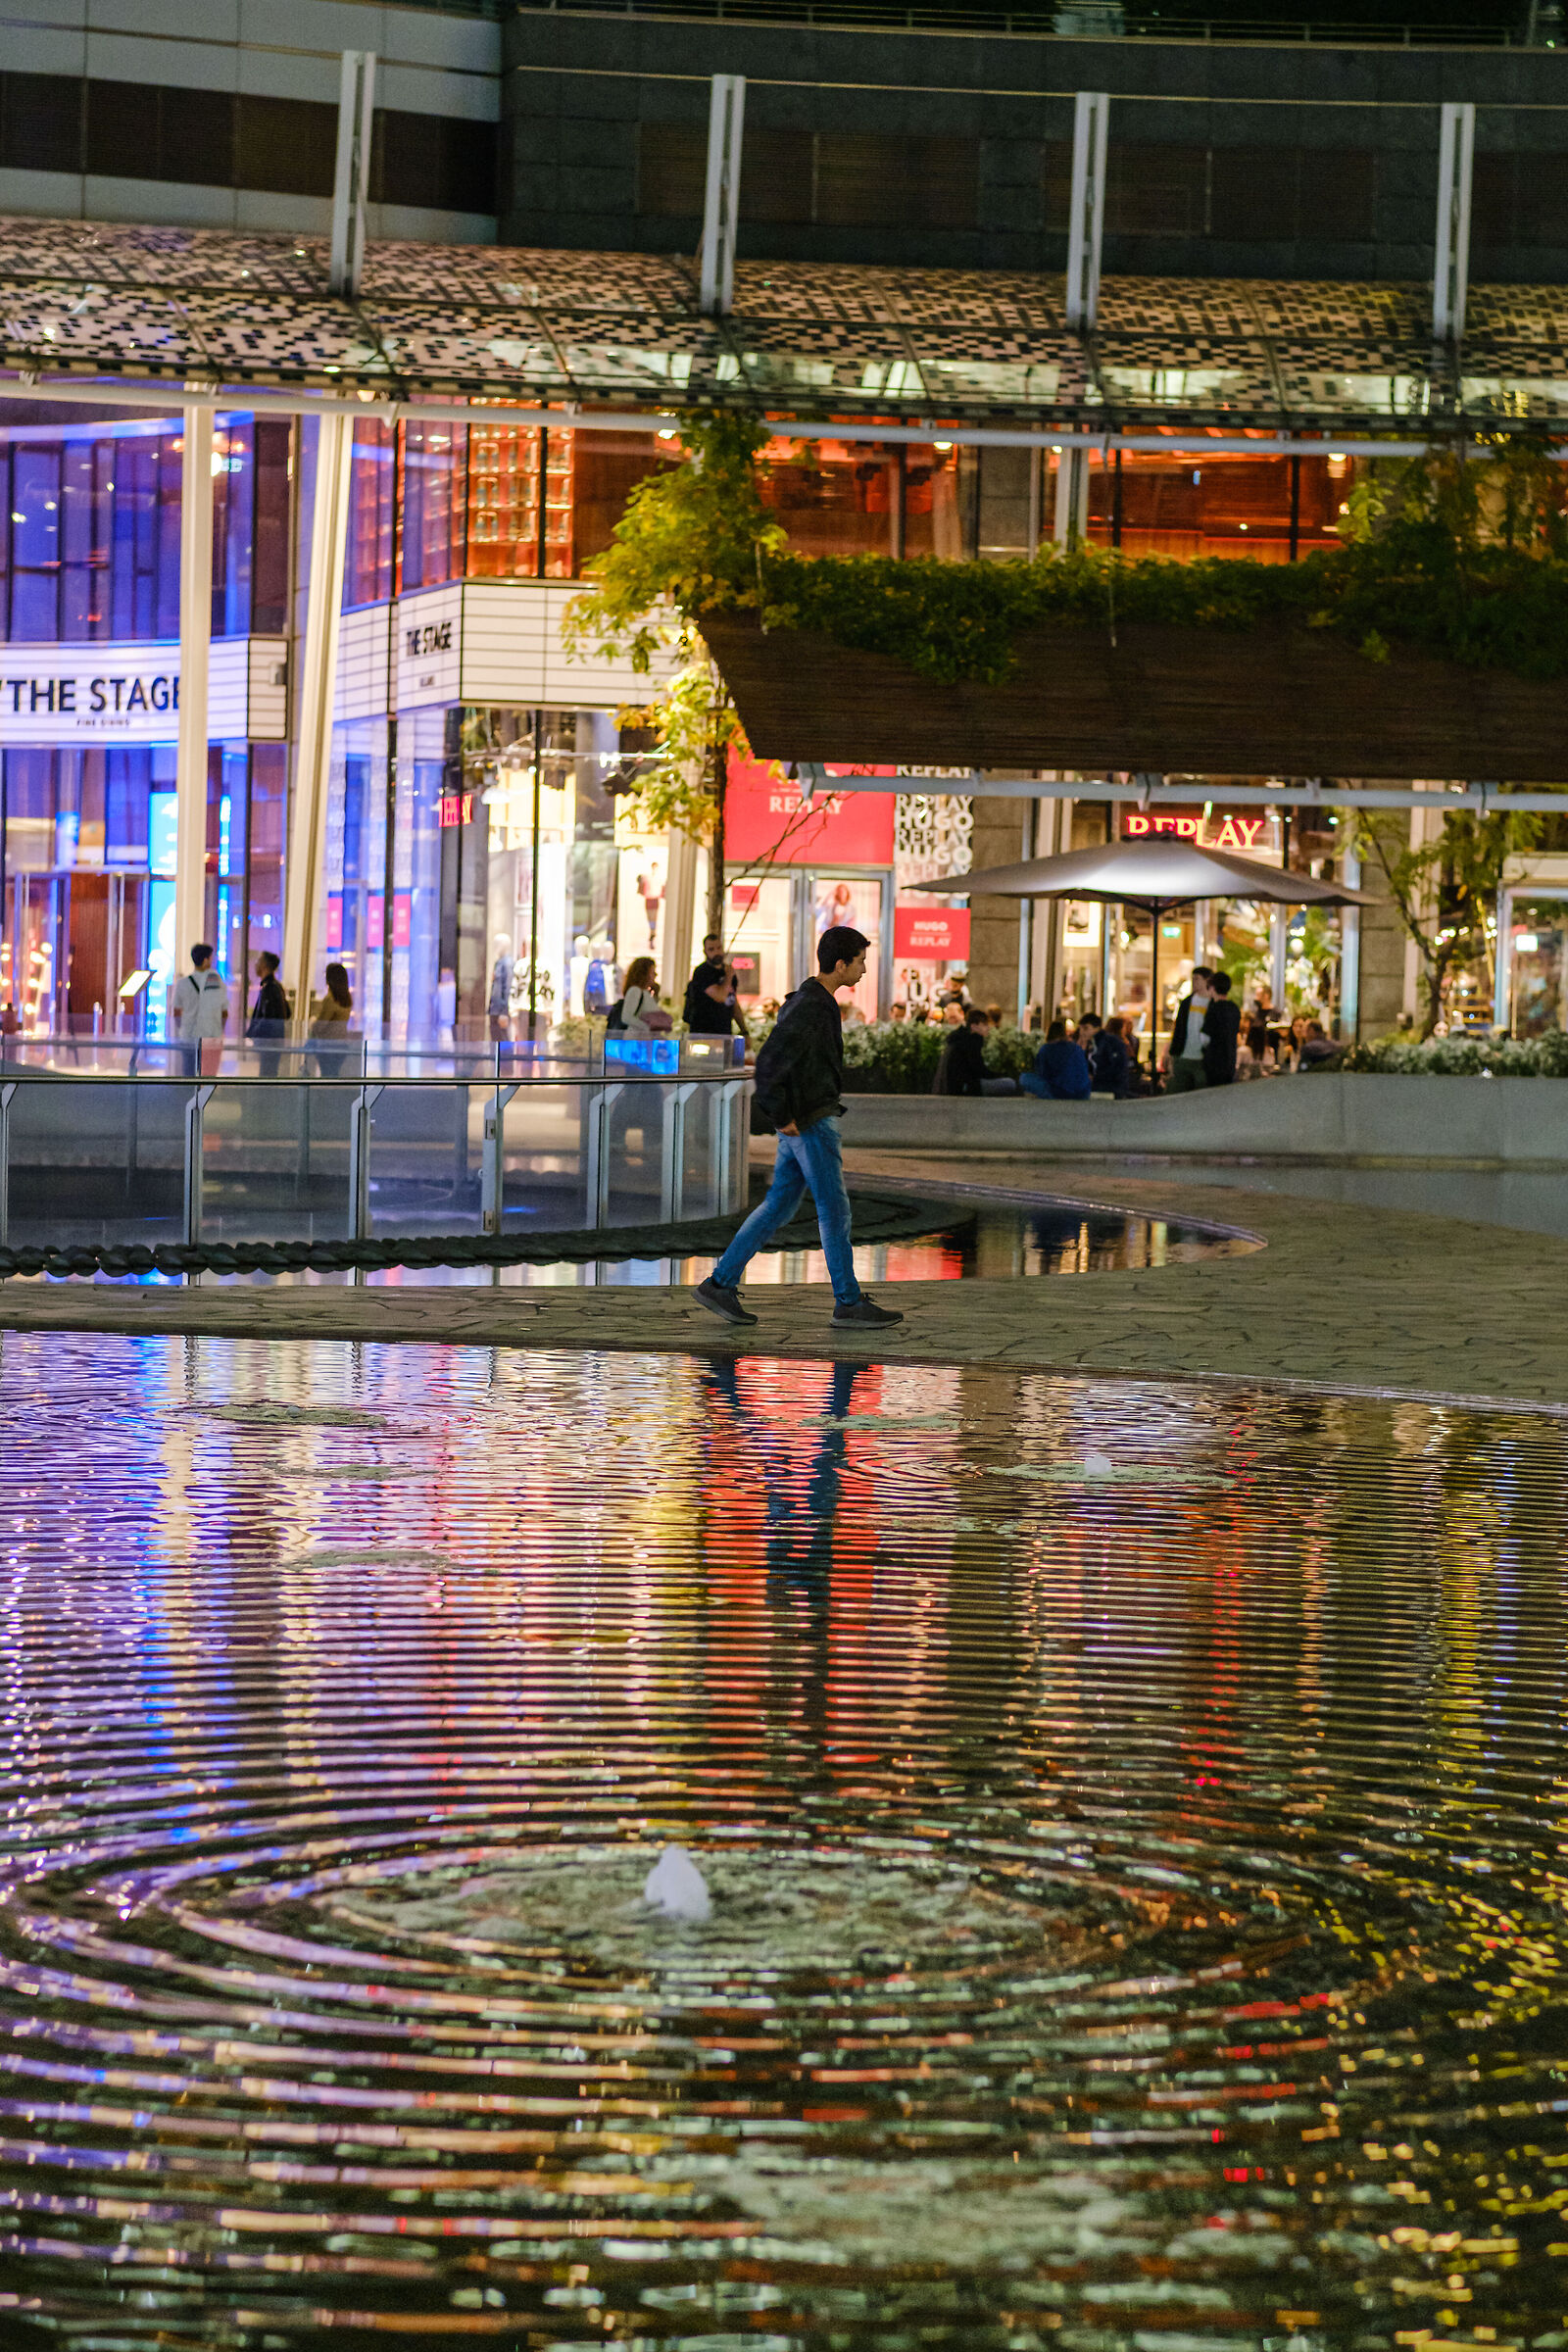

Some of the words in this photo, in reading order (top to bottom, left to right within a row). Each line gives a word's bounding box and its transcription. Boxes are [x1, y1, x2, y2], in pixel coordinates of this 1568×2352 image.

[407, 629, 420, 656] THE
[423, 621, 452, 654] STAGE
[6, 679, 76, 711] THE
[896, 794, 974, 812] REPLAY
[895, 809, 974, 831] HUGO
[896, 829, 972, 846] REPLAY
[894, 844, 973, 865] HUGO
[913, 921, 949, 932] HUGO
[909, 936, 951, 948] REPLAY
